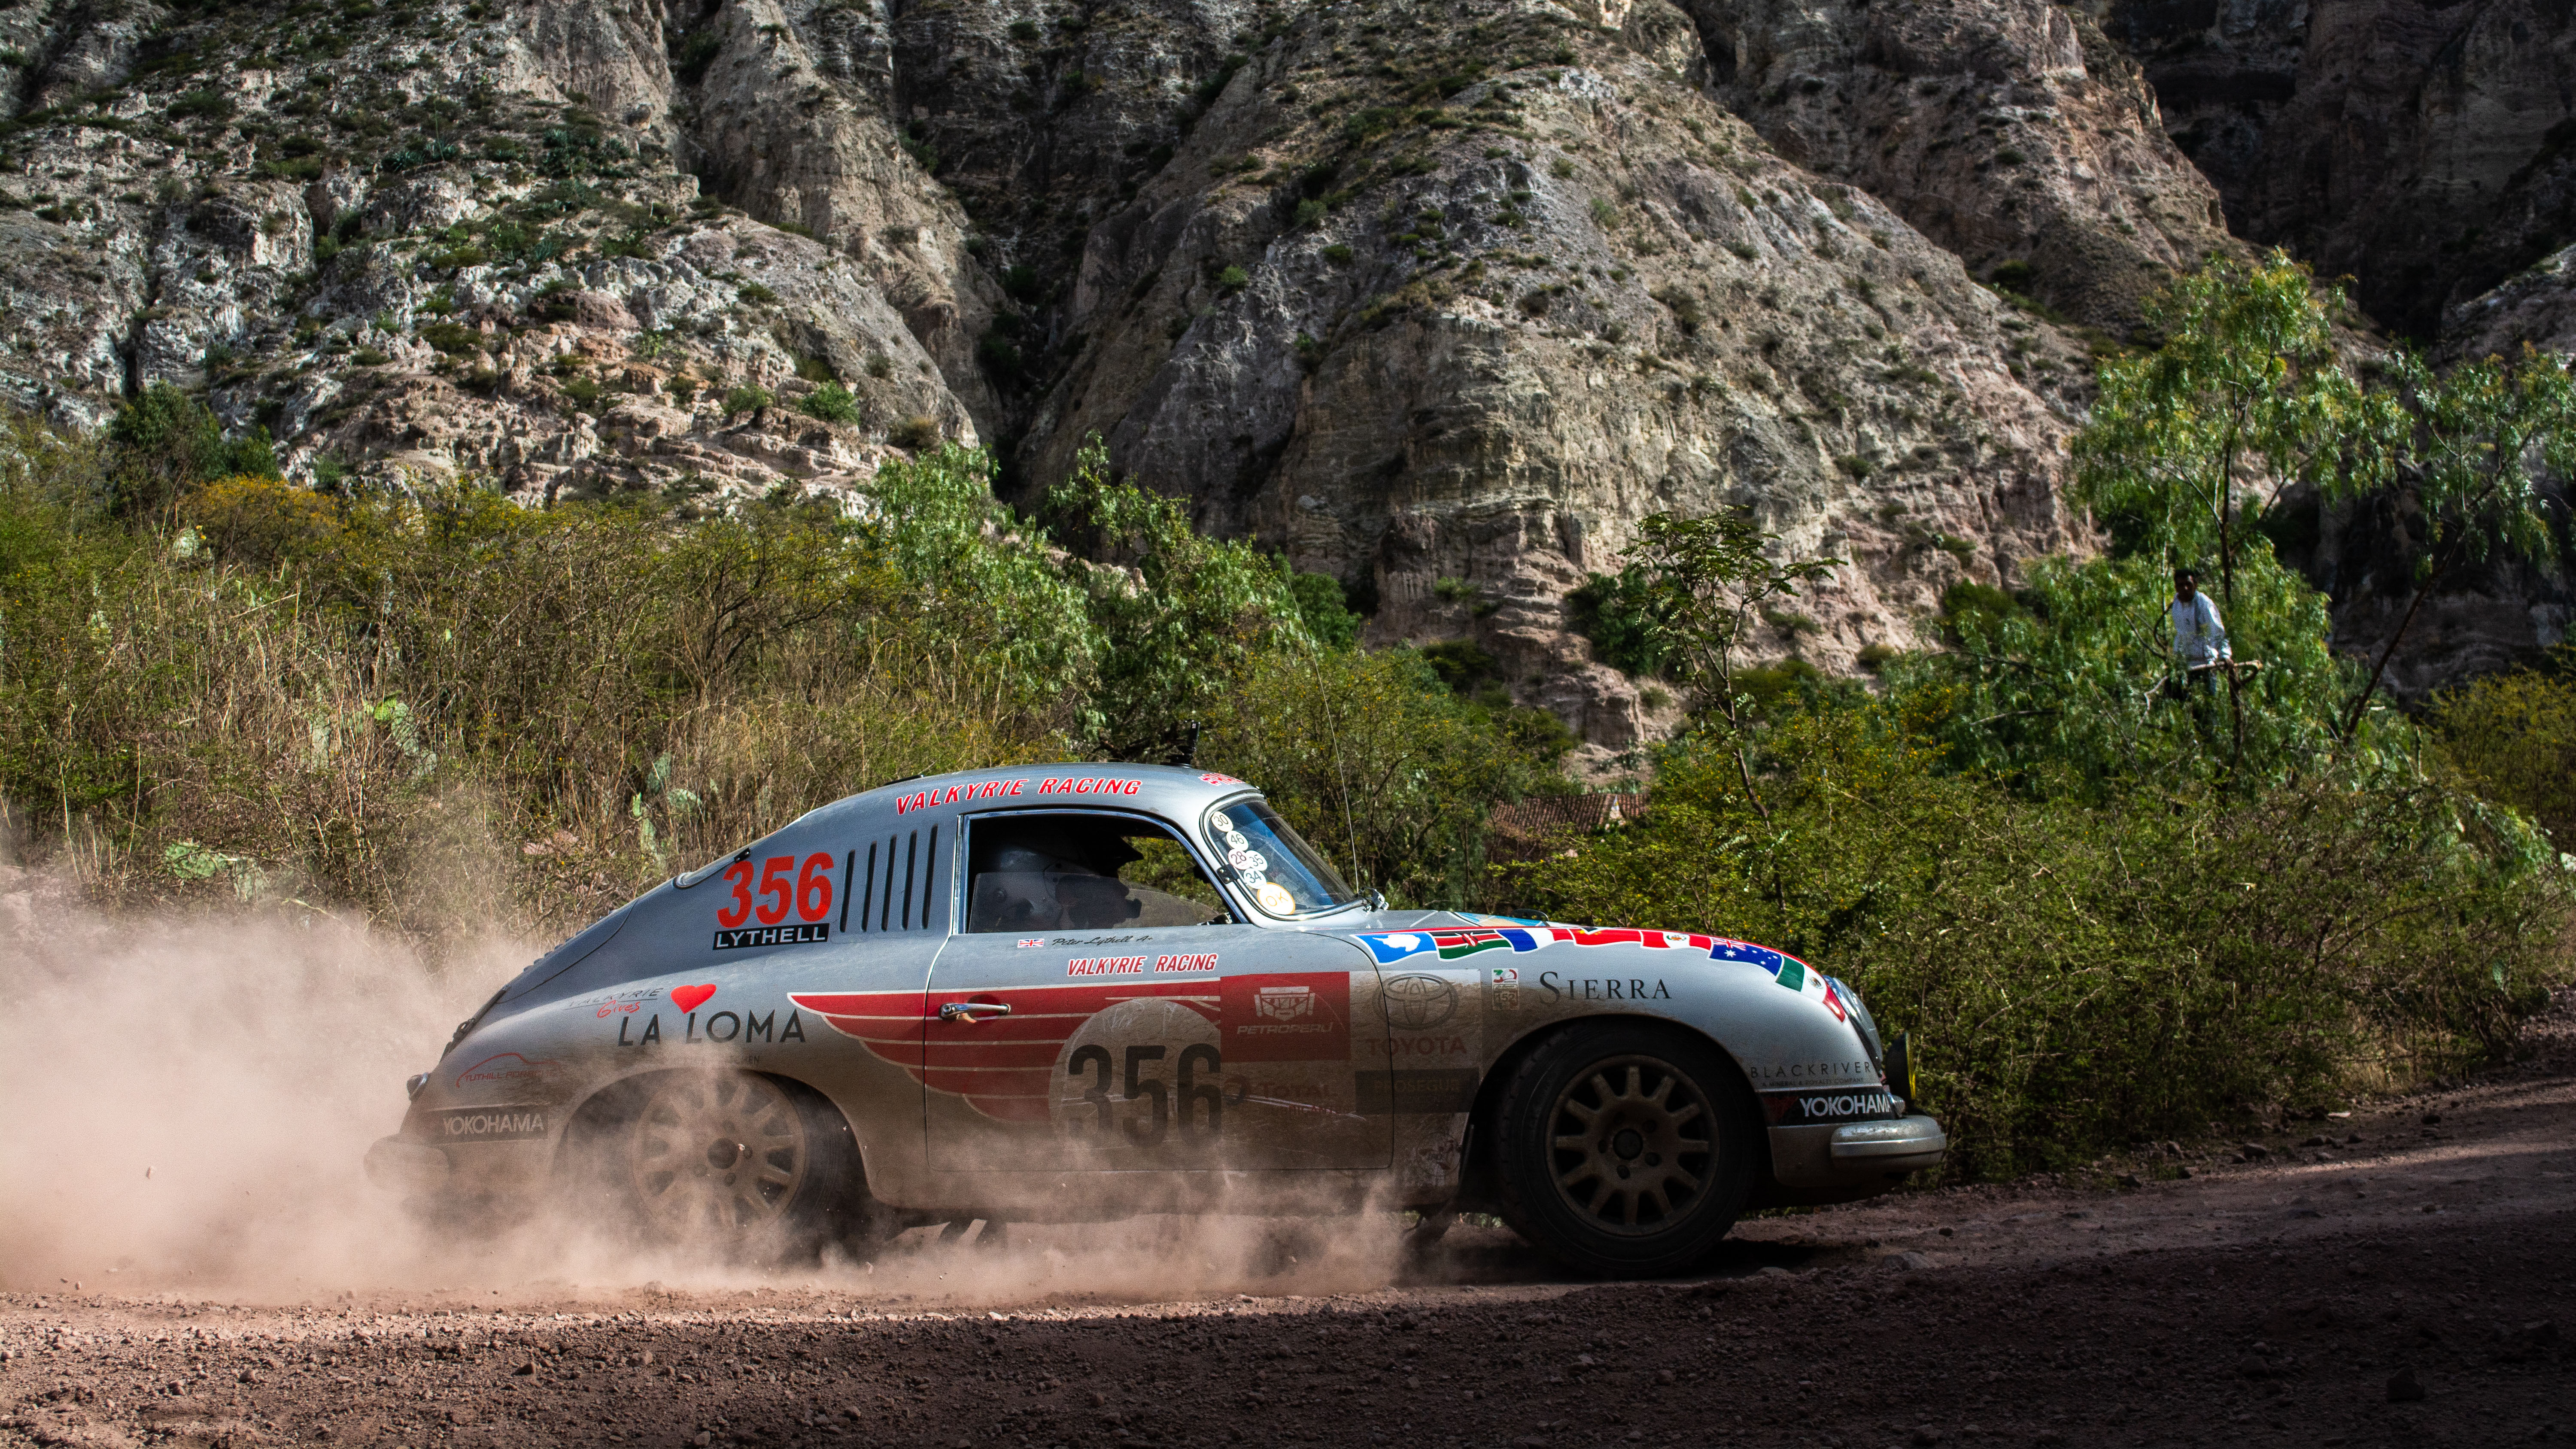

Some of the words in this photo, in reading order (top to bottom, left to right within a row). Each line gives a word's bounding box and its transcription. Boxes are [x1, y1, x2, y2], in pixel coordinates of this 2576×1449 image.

[896, 778, 1029, 815] VALKYRIE
[1038, 778, 1142, 796] RACING
[1214, 814, 1229, 826] 30
[1230, 834, 1245, 844] 46
[1230, 851, 1247, 865] 28
[1249, 854, 1264, 867] 35
[1245, 871, 1261, 884] 34
[717, 852, 834, 928] 356
[716, 926, 826, 948] LYTHELL
[1052, 938, 1083, 946] Peter
[1084, 935, 1133, 946] Lythell
[1067, 955, 1148, 977] VALKYRIE
[1154, 953, 1218, 973] RACING
[1539, 971, 1672, 1005] SIERRA
[596, 999, 641, 1018] Gives
[618, 1013, 661, 1046] LA
[686, 1008, 806, 1043] LOMA
[1365, 1036, 1467, 1056] TOYOTA
[465, 1072, 502, 1081] TUTHILL
[1750, 1061, 1871, 1078] BLACKRIVER
[1068, 1043, 1222, 1149] 356
[443, 1113, 544, 1135] YOKOHAMA
